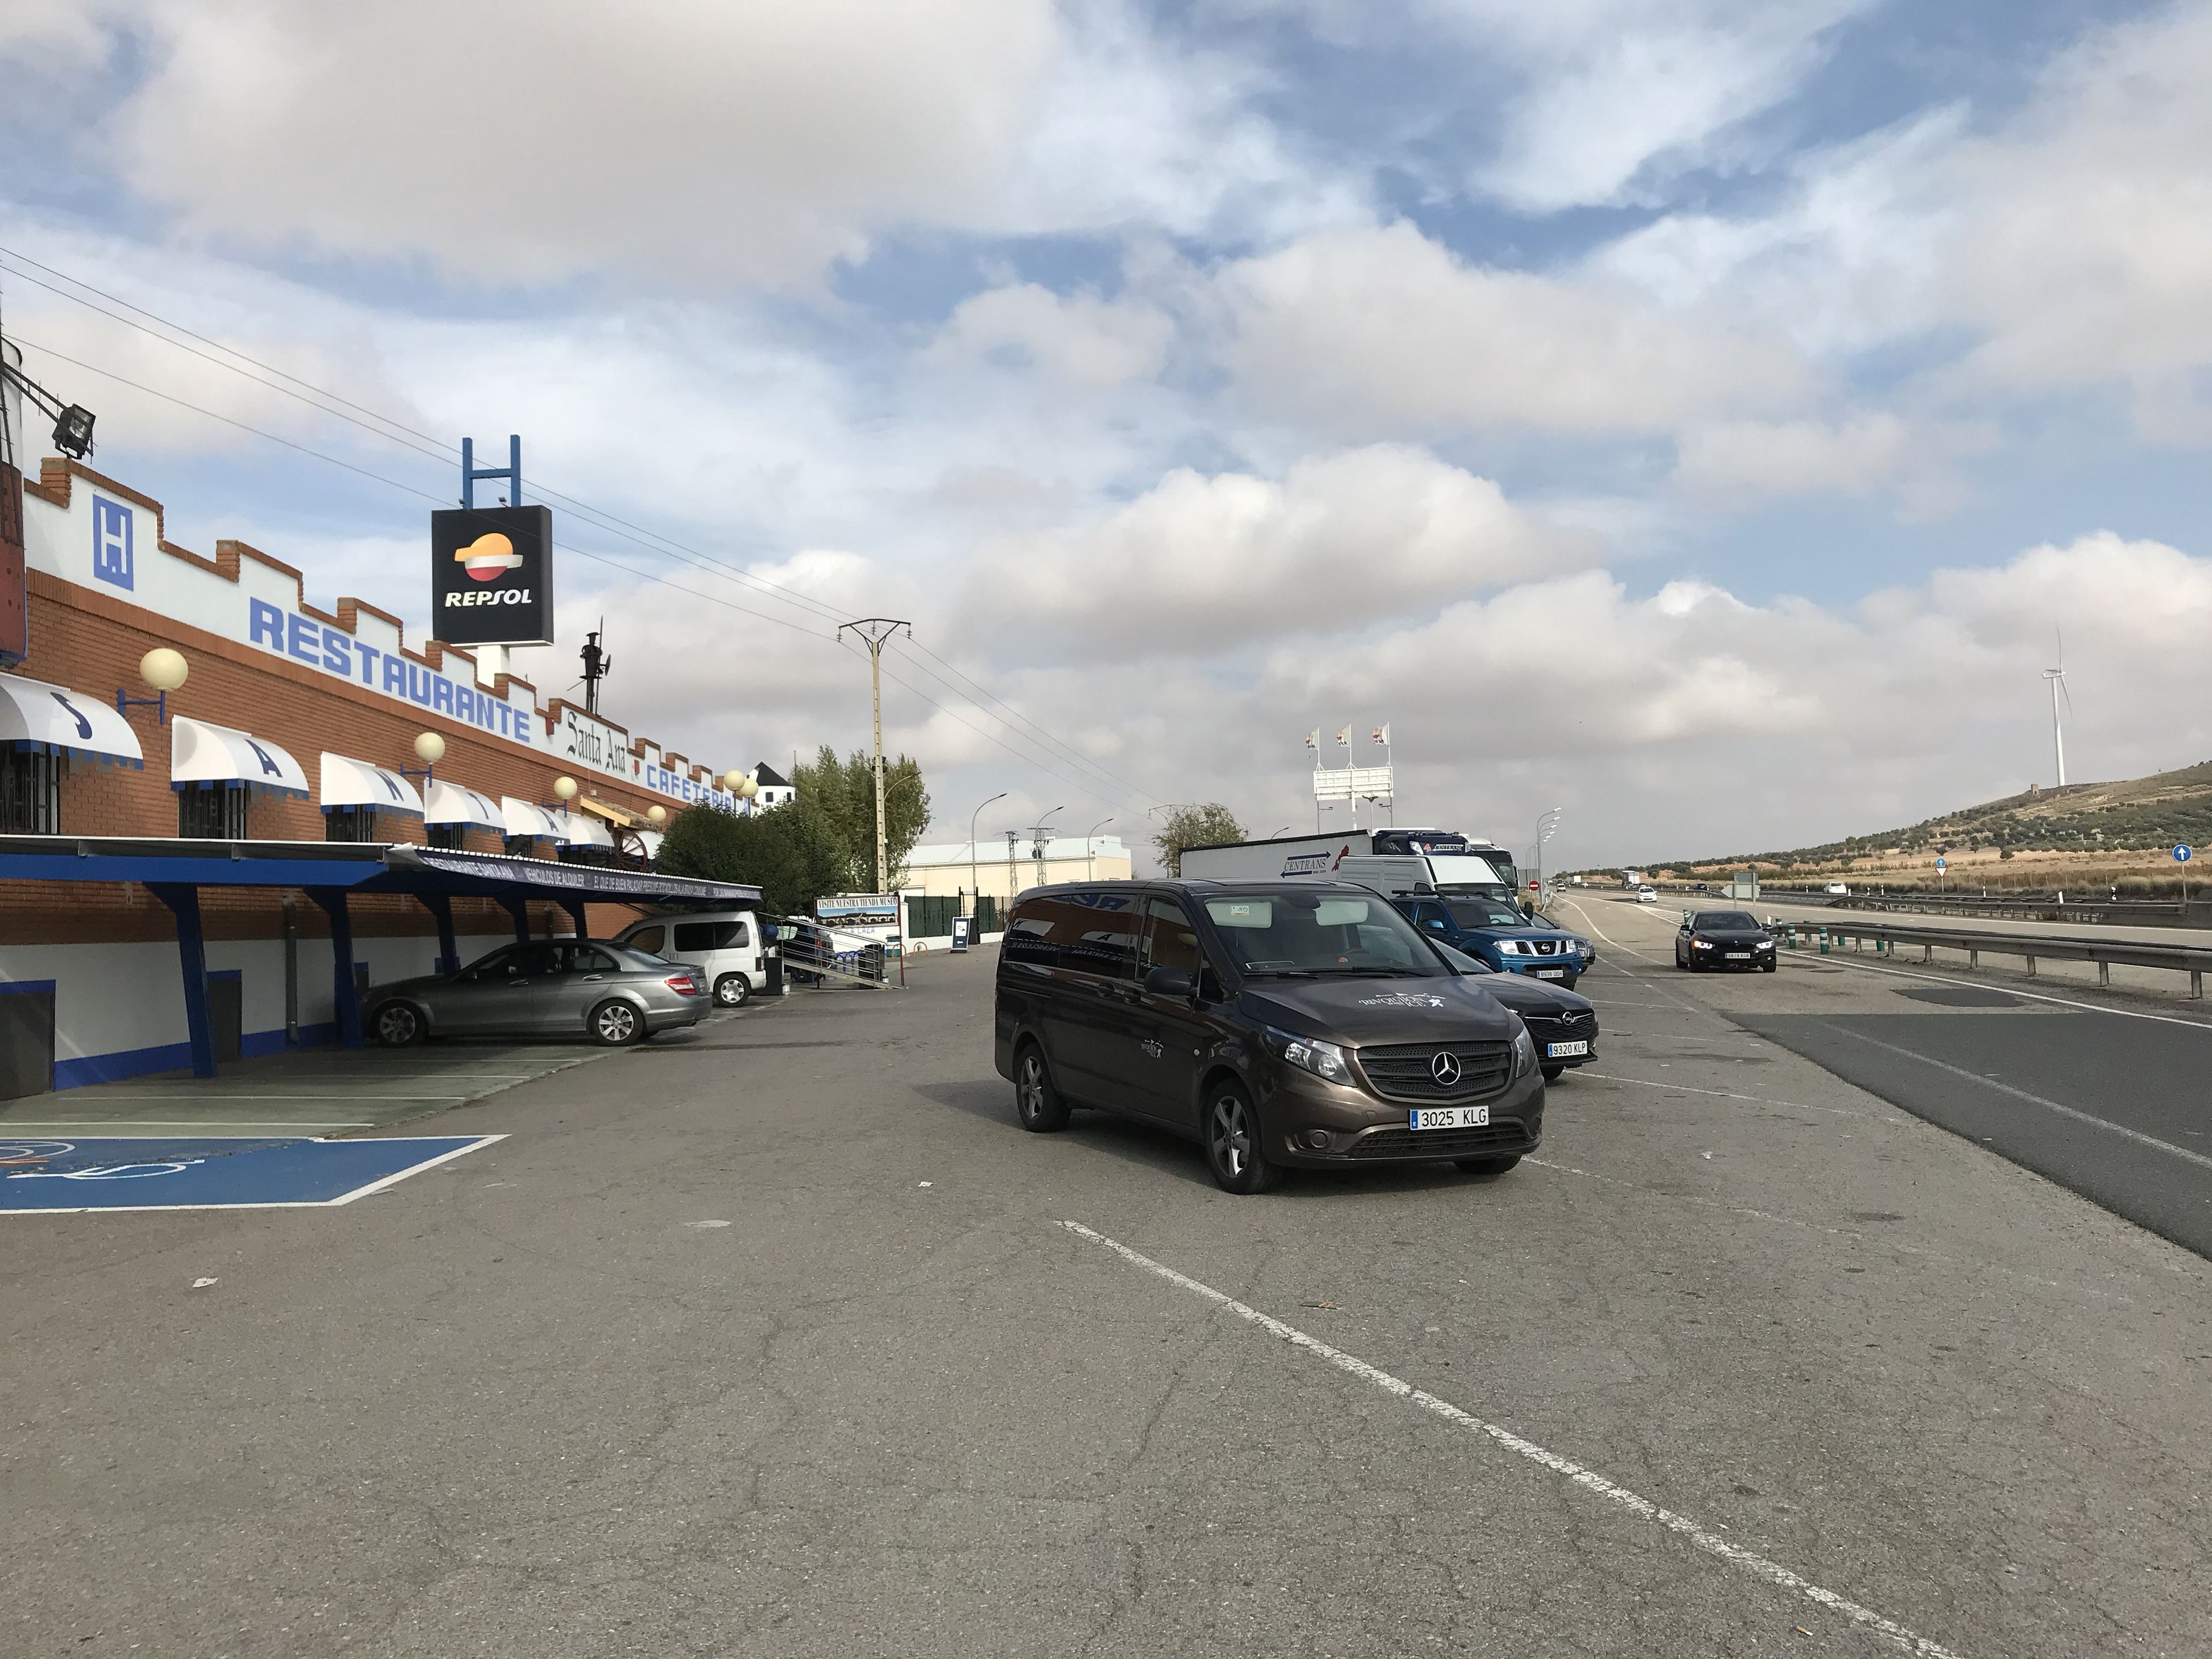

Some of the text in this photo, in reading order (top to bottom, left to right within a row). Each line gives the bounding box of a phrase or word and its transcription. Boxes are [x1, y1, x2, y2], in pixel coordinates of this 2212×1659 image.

[100, 506, 127, 575] H
[445, 589, 532, 608] REPSOL
[250, 597, 531, 743] RESTAURANTE
[567, 711, 626, 774] Santa Ana
[1284, 859, 1326, 871] CENTRANS
[554, 871, 562, 885] DE
[819, 897, 897, 908] VISITE NUESTRA TIENDA MUSEO
[1553, 1043, 1585, 1055] 9320 KLP
[1422, 1111, 1454, 1127] 3025
[1463, 1108, 1487, 1124] KLG
